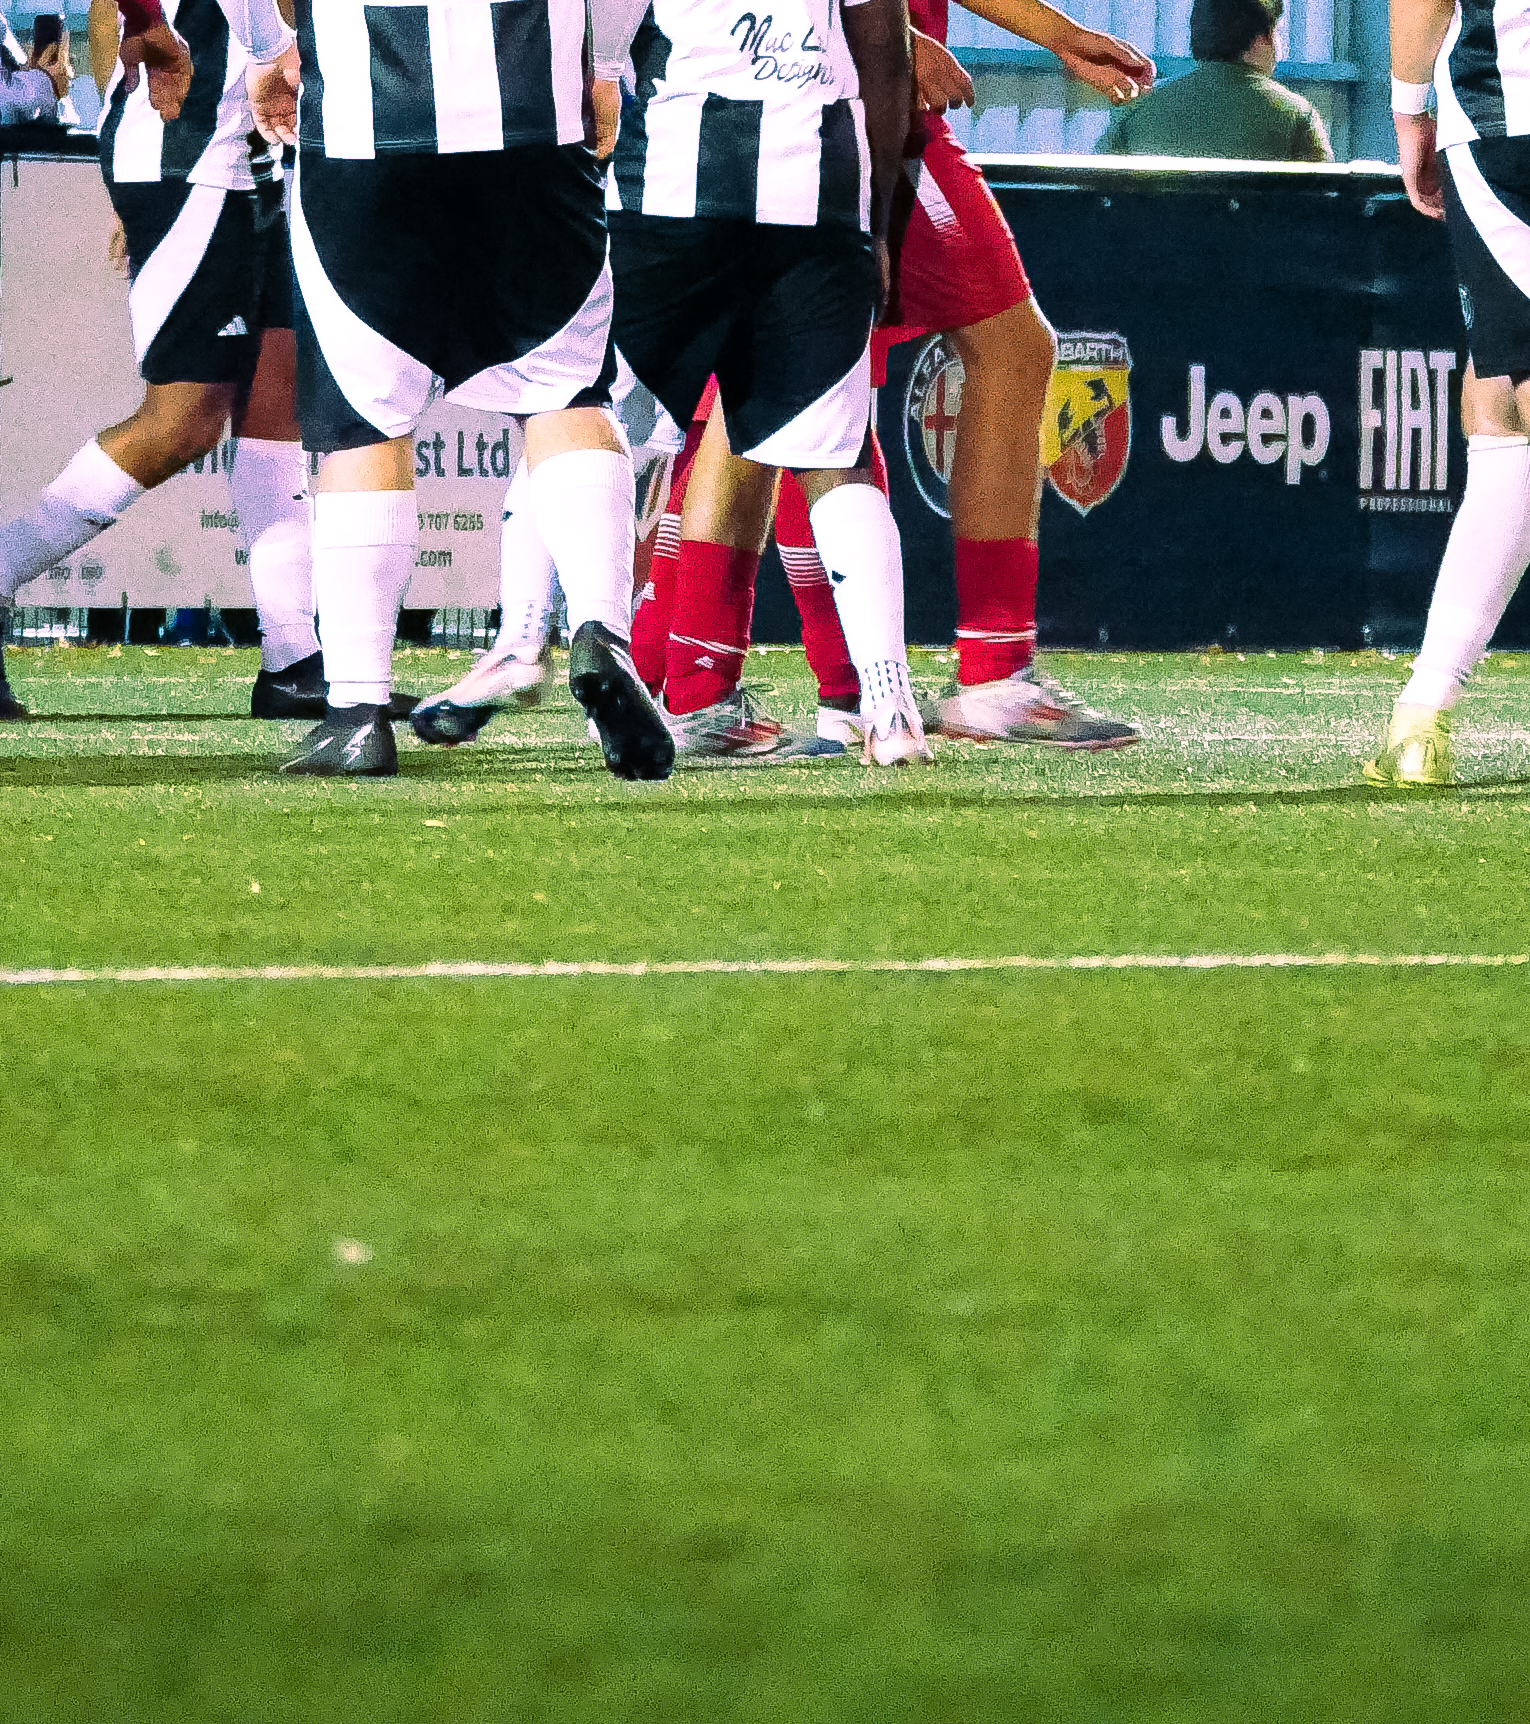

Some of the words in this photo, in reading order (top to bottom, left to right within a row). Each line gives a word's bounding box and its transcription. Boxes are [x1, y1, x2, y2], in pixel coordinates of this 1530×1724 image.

[456, 428, 511, 478] Ltd
[1161, 363, 1331, 486] Jeep
[1359, 349, 1457, 491] FIAT
